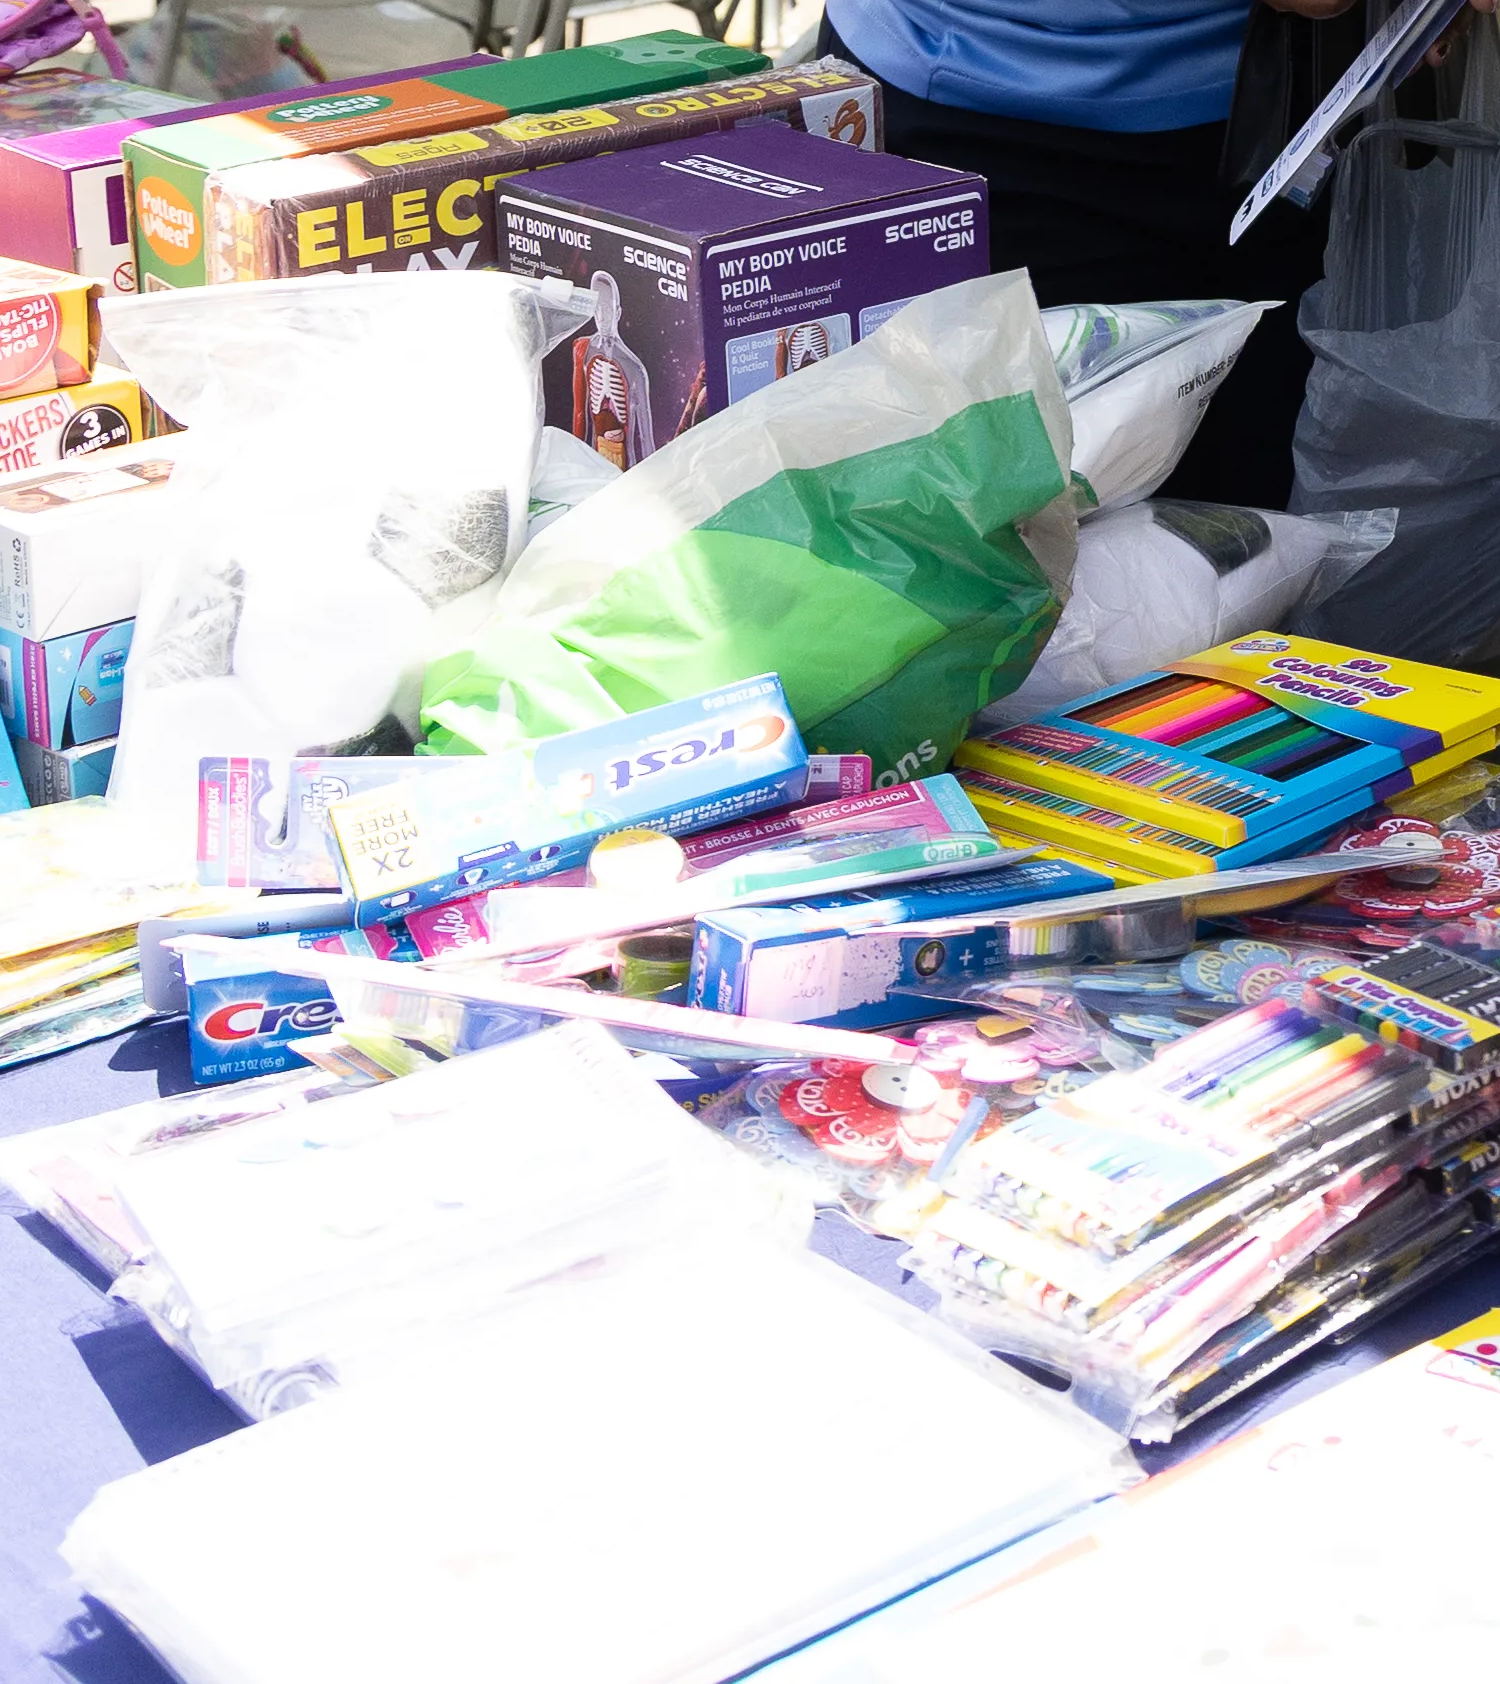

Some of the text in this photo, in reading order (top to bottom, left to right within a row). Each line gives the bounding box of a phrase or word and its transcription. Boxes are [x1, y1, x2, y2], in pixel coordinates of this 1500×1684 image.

[276, 94, 381, 118] Pottery
[636, 73, 852, 119] ELECTRO
[289, 102, 382, 123] Wheel
[142, 189, 195, 235] Pottery
[143, 217, 190, 249] Wheel
[507, 212, 593, 251] MY BODY VOICE
[508, 233, 542, 257] PEDIA
[719, 236, 847, 279] MY BODY VOICE
[721, 275, 772, 301] PEDIA
[723, 279, 842, 315] Mon Corps Humain Interactif
[723, 317, 736, 327] Mi
[737, 308, 771, 328] pediatra
[771, 306, 783, 318] de
[799, 294, 833, 314] corporal
[0, 315, 49, 341] FLIPS
[731, 335, 784, 354] Cool Booklet
[739, 351, 759, 365] Quiz
[732, 359, 770, 377] Function
[79, 411, 101, 440] 3
[66, 425, 126, 460] GAMES IN
[1259, 672, 1367, 707] Pencils
[1271, 657, 1411, 699] Colouring
[609, 715, 786, 791] Crest
[351, 809, 410, 832] FREE
[706, 789, 910, 849] BROSSE DENTS AVEC CAPUCHON
[351, 824, 419, 857] MORE
[372, 846, 414, 877] 2X
[204, 998, 344, 1041] Cre
[202, 1064, 218, 1077] NET
[218, 1063, 233, 1075] WT
[233, 1060, 247, 1073] 2.3
[247, 1059, 258, 1071] OZ
